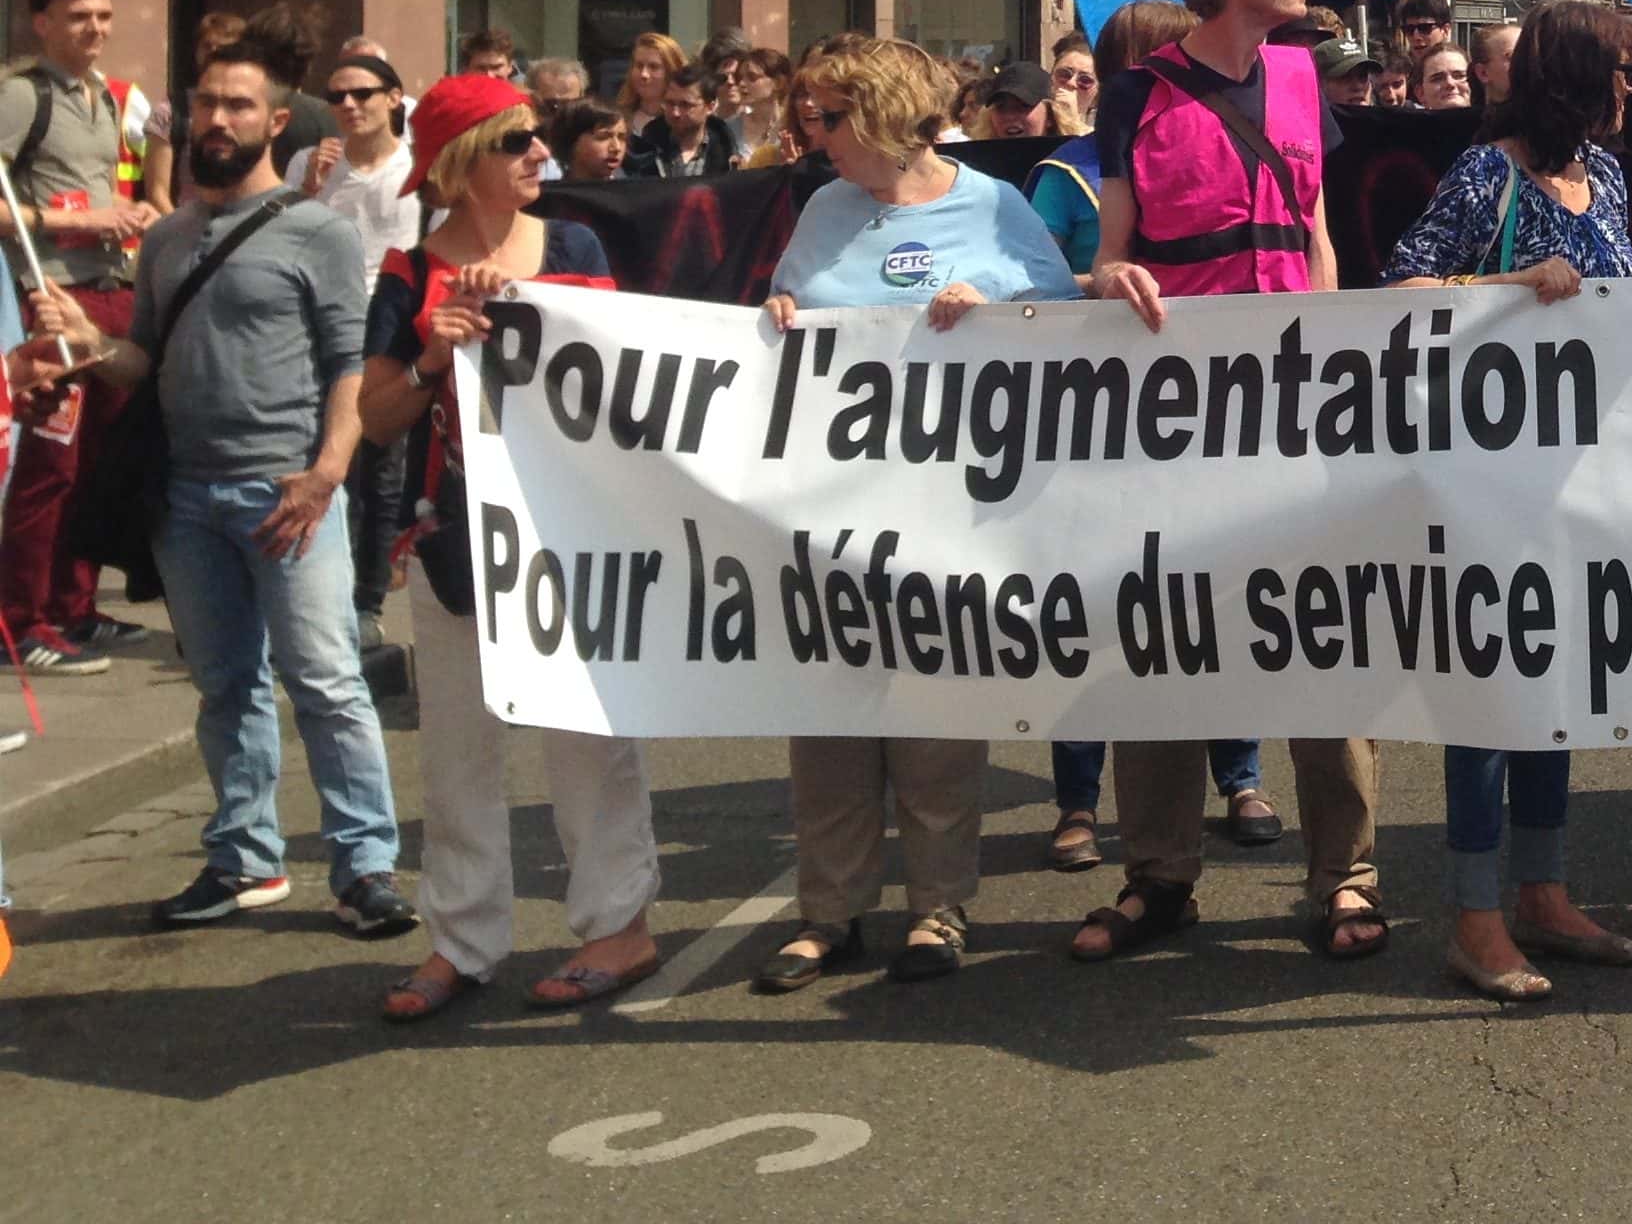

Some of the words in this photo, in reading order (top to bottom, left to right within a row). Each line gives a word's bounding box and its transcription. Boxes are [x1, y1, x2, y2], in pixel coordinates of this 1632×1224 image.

[887, 254, 931, 270] CFTC
[479, 301, 740, 454] Pour
[762, 309, 1599, 503] l'augmentation
[481, 500, 662, 664] Pour
[682, 517, 757, 662] la
[780, 528, 1090, 680] défense
[1116, 530, 1221, 677] du
[1245, 524, 1557, 679] service
